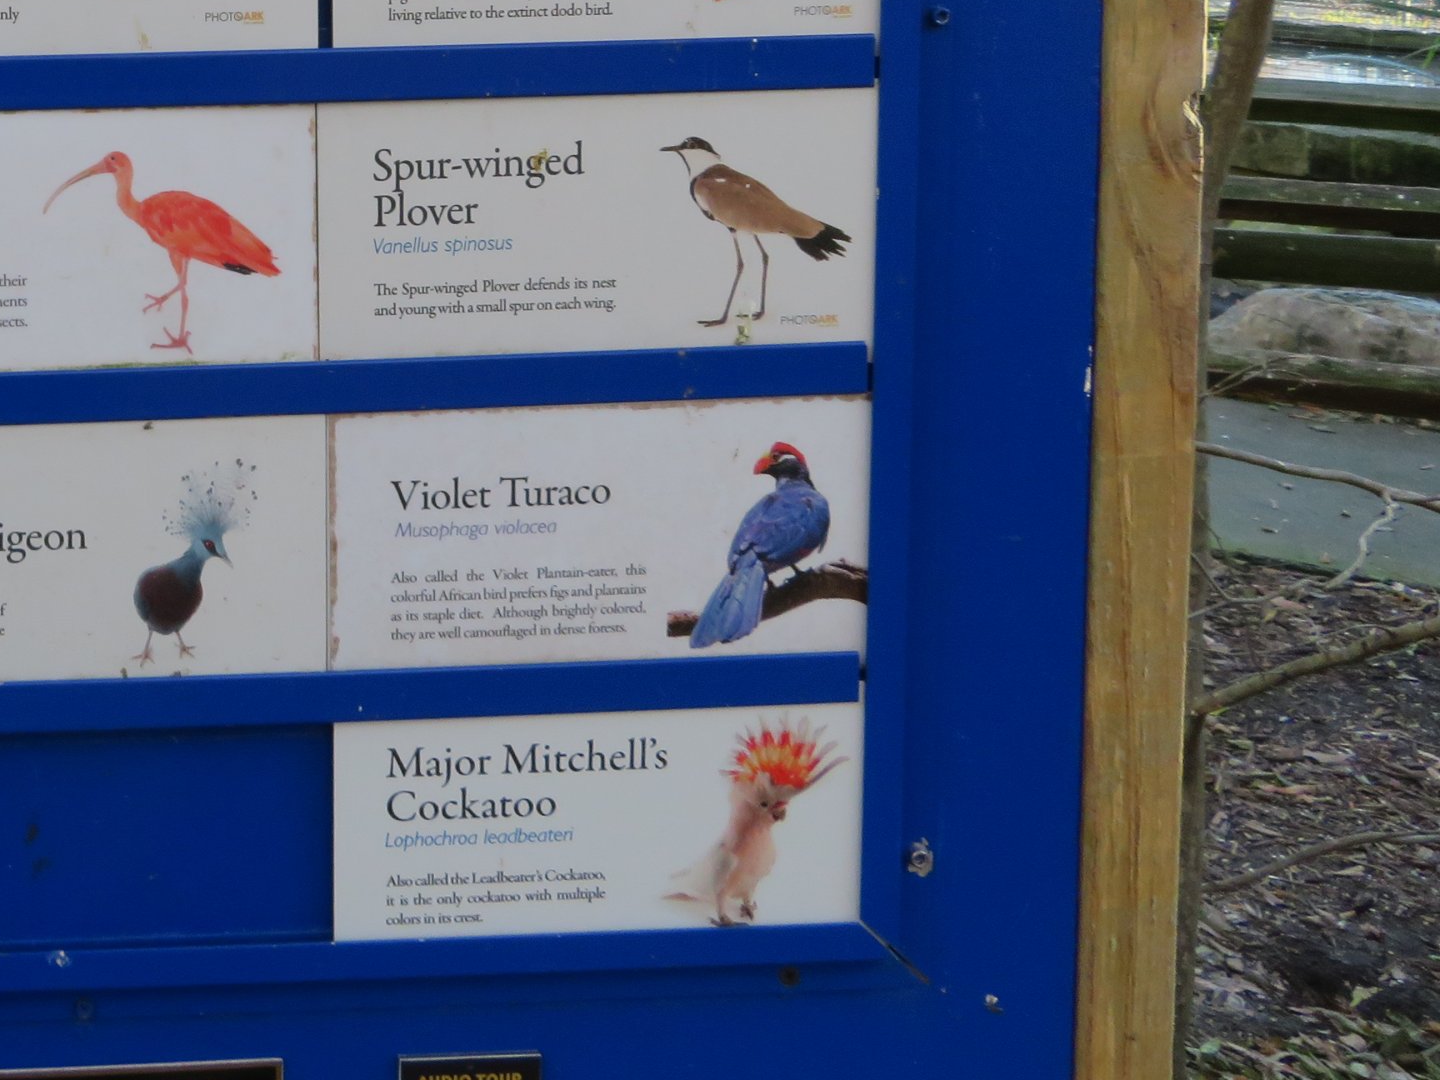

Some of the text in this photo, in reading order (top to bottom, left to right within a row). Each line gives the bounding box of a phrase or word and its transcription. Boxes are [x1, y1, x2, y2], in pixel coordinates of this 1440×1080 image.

[388, 1, 613, 25] living relative to the extinct dodo bird.
[372, 139, 584, 193] Spur-winged
[373, 187, 478, 227] Plover
[371, 234, 513, 256] Vanellus spinosus
[373, 275, 616, 299] The Spur-winged Plover defends its nest
[390, 474, 610, 510] Violet Turaco
[395, 518, 557, 542] Musophaga violacea
[390, 620, 626, 643] they are well camouflaged in dense forests.
[386, 745, 491, 787] Major
[386, 787, 556, 821] Cockatoo
[384, 829, 478, 852] Lophochroa
[386, 885, 605, 908] it is the only cockatoo with multiple
